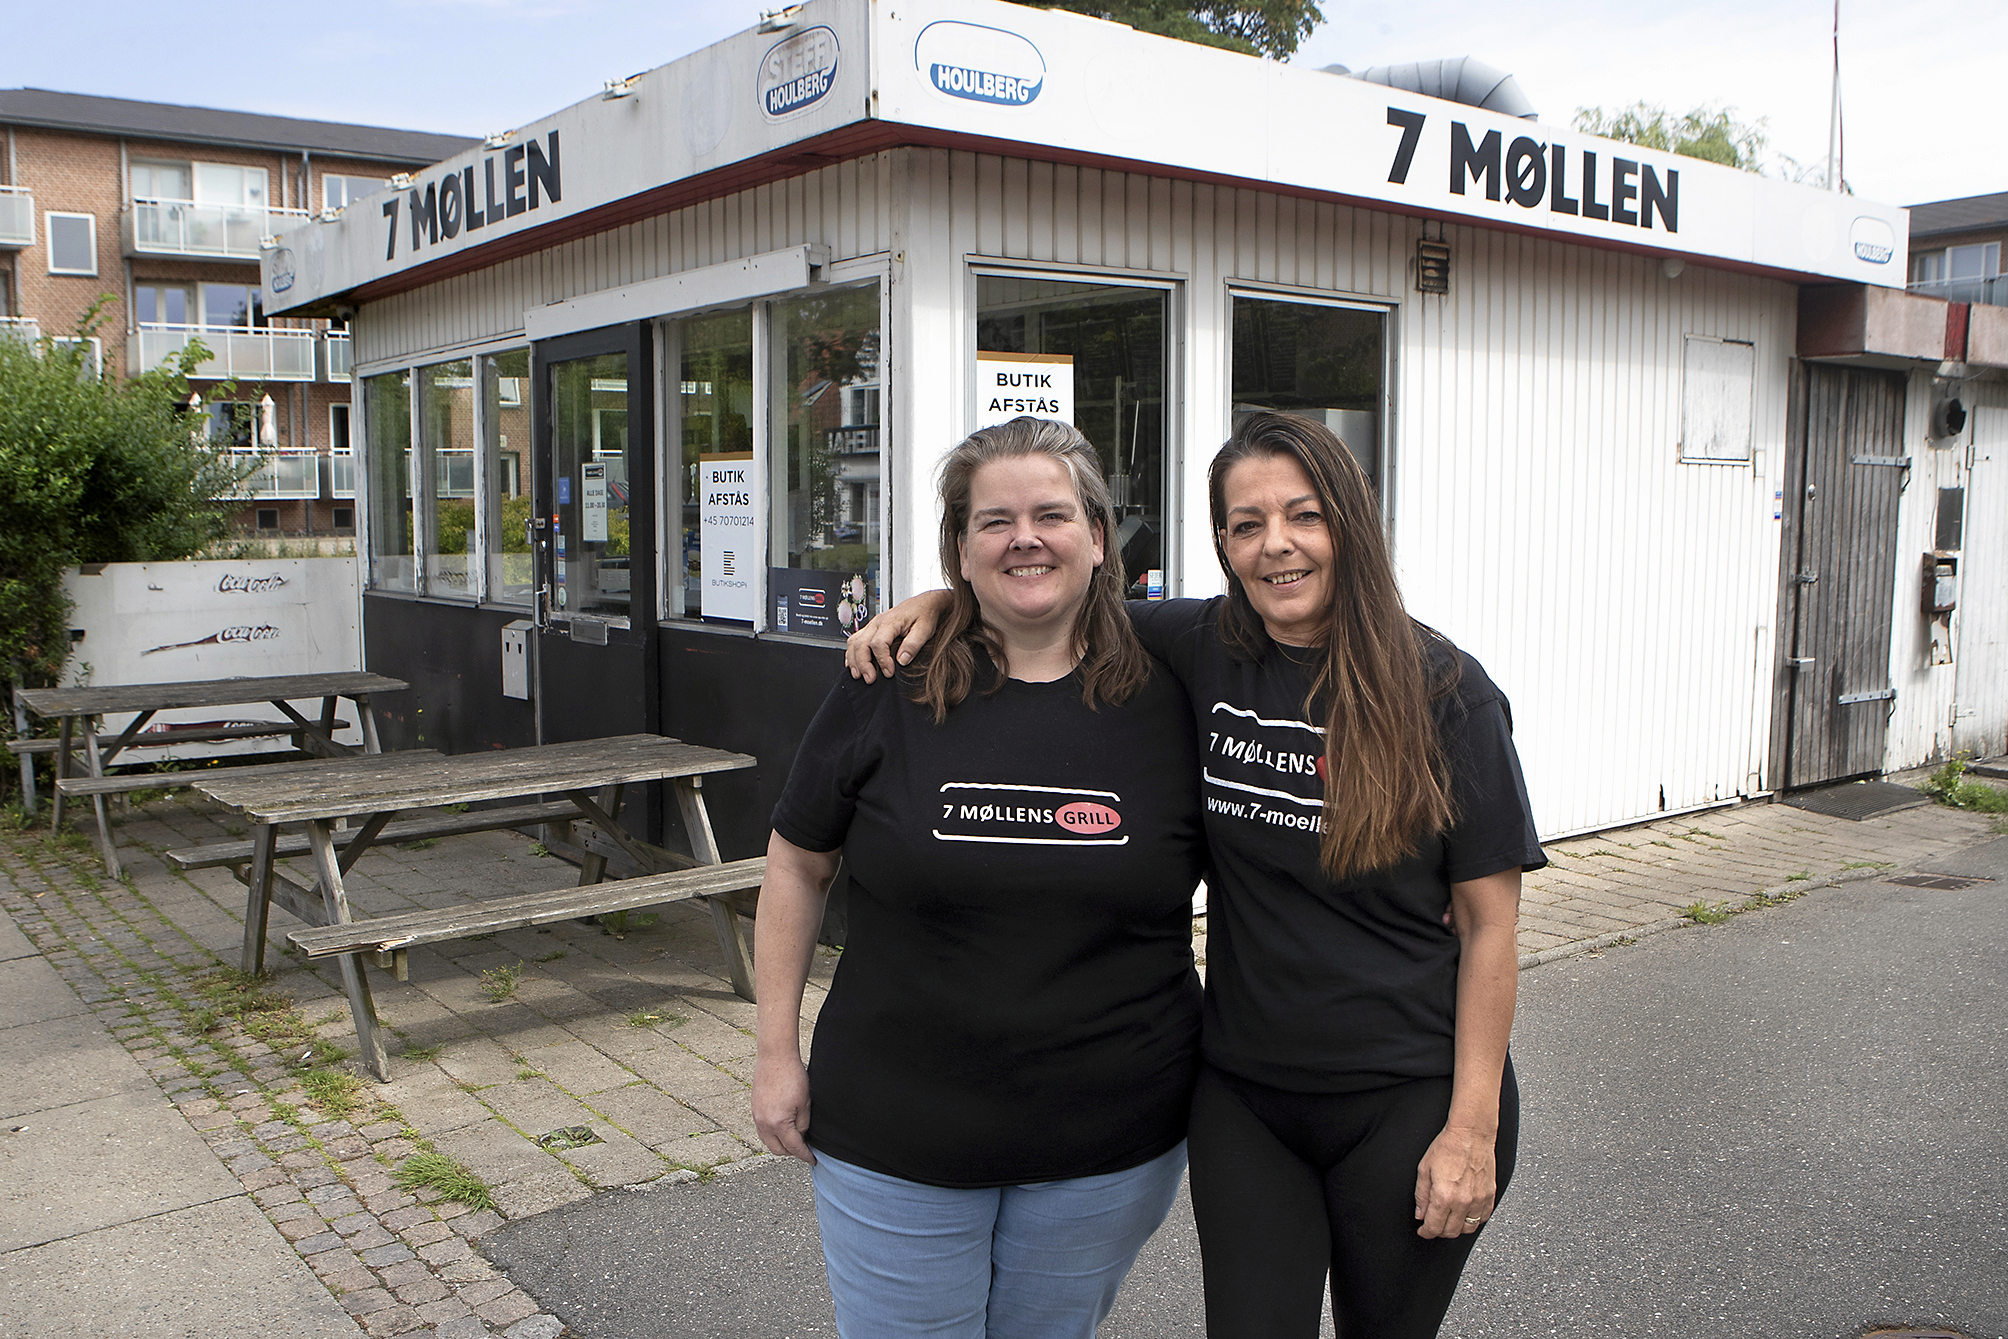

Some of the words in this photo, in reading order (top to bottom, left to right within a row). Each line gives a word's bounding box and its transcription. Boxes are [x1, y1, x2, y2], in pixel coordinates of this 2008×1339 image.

[770, 69, 828, 112] HOULBERG
[937, 65, 1029, 102] HOULBERG
[1386, 106, 1427, 185] 7
[1449, 120, 1680, 234] MØLLEN
[382, 197, 400, 261] 7
[409, 129, 562, 252] MØLLEN
[996, 372, 1052, 388] BUTIK
[988, 396, 1060, 414] AFSTÅS
[712, 470, 745, 484] BUTIK
[708, 490, 750, 506] AFSTÅS
[703, 515, 718, 526] +45
[719, 515, 754, 527] 70701214
[1209, 731, 1220, 752] 7
[1221, 736, 1317, 776] MØLLENS
[942, 803, 954, 819] 7
[959, 803, 1054, 824] MØLLENS
[1063, 811, 1115, 825] GRILL
